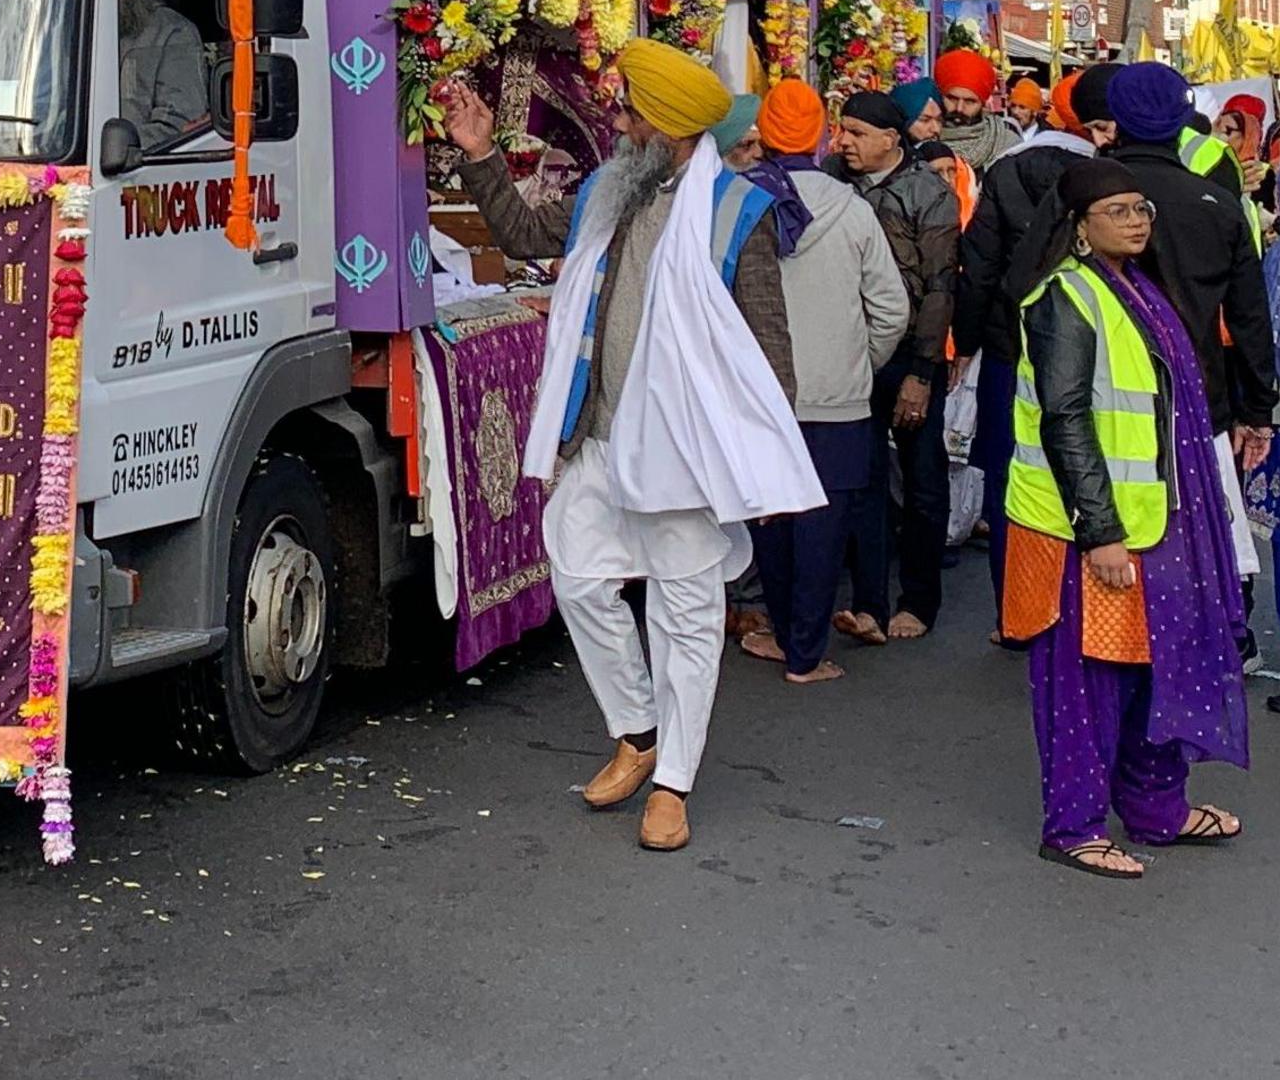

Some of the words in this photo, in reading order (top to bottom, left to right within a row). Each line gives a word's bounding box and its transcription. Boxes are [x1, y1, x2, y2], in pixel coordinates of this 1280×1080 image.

[121, 180, 201, 239] TRUCK
[205, 173, 280, 231] RETAL
[155, 310, 174, 359] by
[182, 311, 258, 349] D.TALLIS
[133, 422, 198, 459] HINCKLEY
